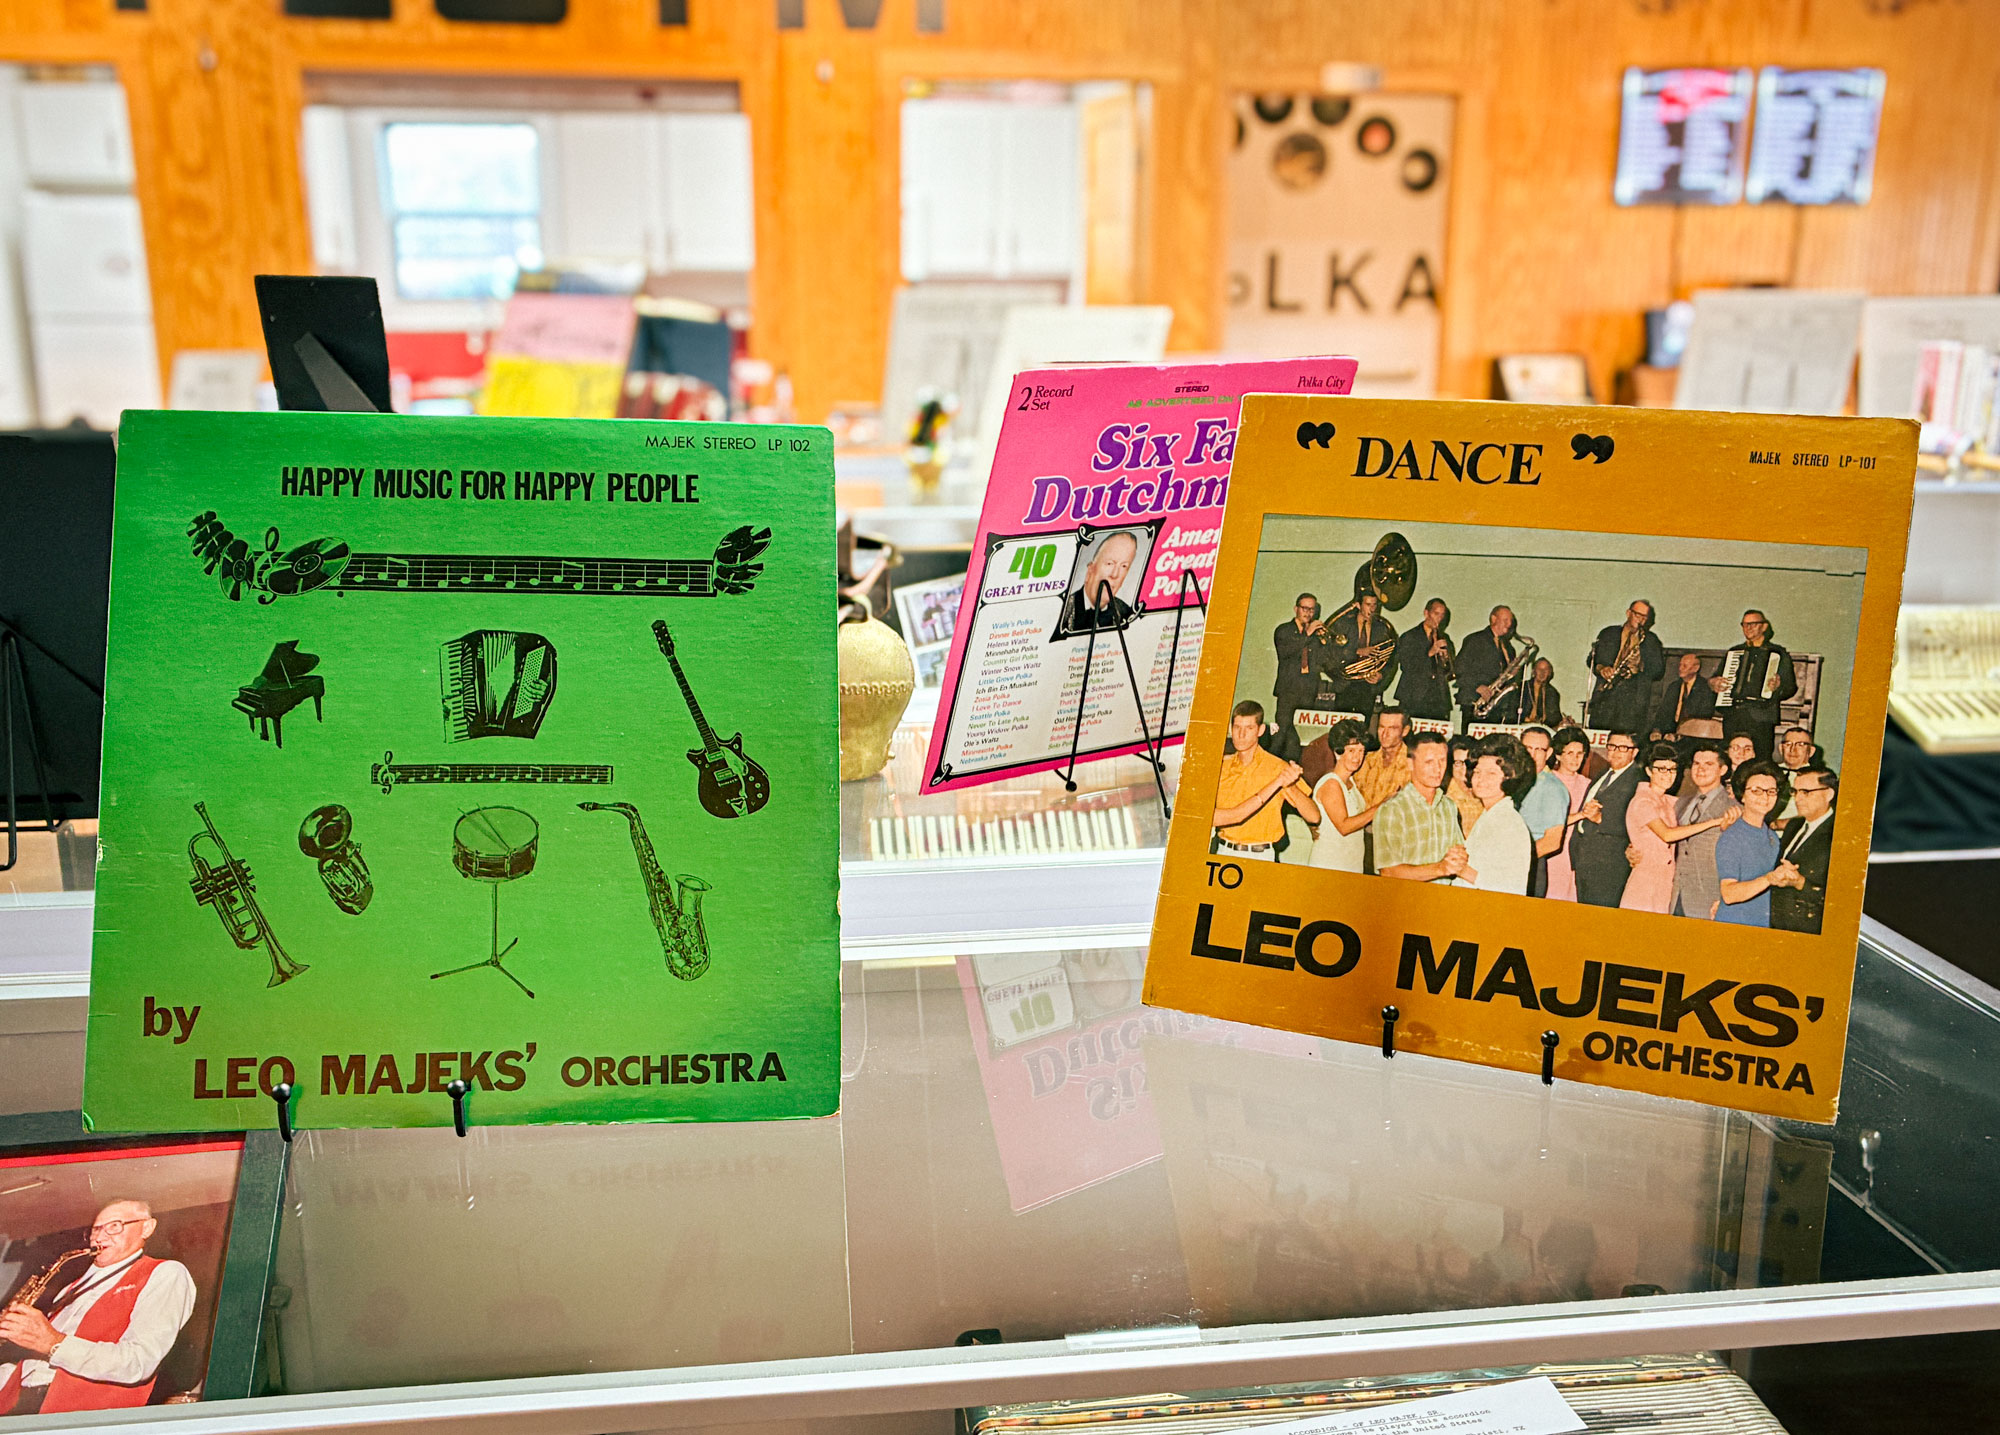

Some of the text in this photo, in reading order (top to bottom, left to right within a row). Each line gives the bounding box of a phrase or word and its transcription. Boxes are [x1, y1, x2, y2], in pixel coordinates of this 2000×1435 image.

[1174, 385, 1209, 393] STEREO
[1297, 375, 1345, 390] Polka City
[1017, 385, 1074, 411] 2 Record
[1031, 399, 1051, 411] Set
[645, 435, 811, 452] MAJEK STEREO LP 102
[1093, 423, 1179, 471] Six
[1351, 437, 1543, 485] DANCE
[1749, 451, 1876, 470] MAJEK STEREO LP-101
[282, 466, 699, 503] HAPPY MUSIC FOR HAPPY PEOPLE
[1008, 544, 1056, 580] 40
[984, 580, 1066, 599] GREAT TUNES
[981, 668, 1002, 676] Winter
[979, 678, 994, 686] Little
[993, 692, 1010, 700] Polka
[976, 704, 991, 712] Love
[1003, 699, 1022, 708] Dance
[1097, 709, 1112, 717] Polka
[968, 722, 986, 730] Never
[1013, 715, 1029, 723] Polka
[970, 709, 1010, 721] Seattle Polka
[1087, 718, 1102, 726] Polka
[967, 730, 986, 739] Young
[1012, 723, 1028, 731] Polka
[982, 737, 999, 745] Waltz
[996, 743, 1013, 751] Polka
[990, 752, 1006, 760] Polka
[1205, 862, 1243, 890] TO
[1190, 902, 1825, 1048] LEO MAJEKS’
[143, 996, 201, 1043] by
[1582, 1030, 1815, 1095] ORCHESTRA
[194, 1042, 787, 1099] LEO MAJEKS’ ORCHESTRA
[1379, 1422, 1412, 1431] played
[1443, 1409, 1491, 1421] accordion
[1413, 1424, 1446, 1432] United
[1450, 1418, 1483, 1427] States
